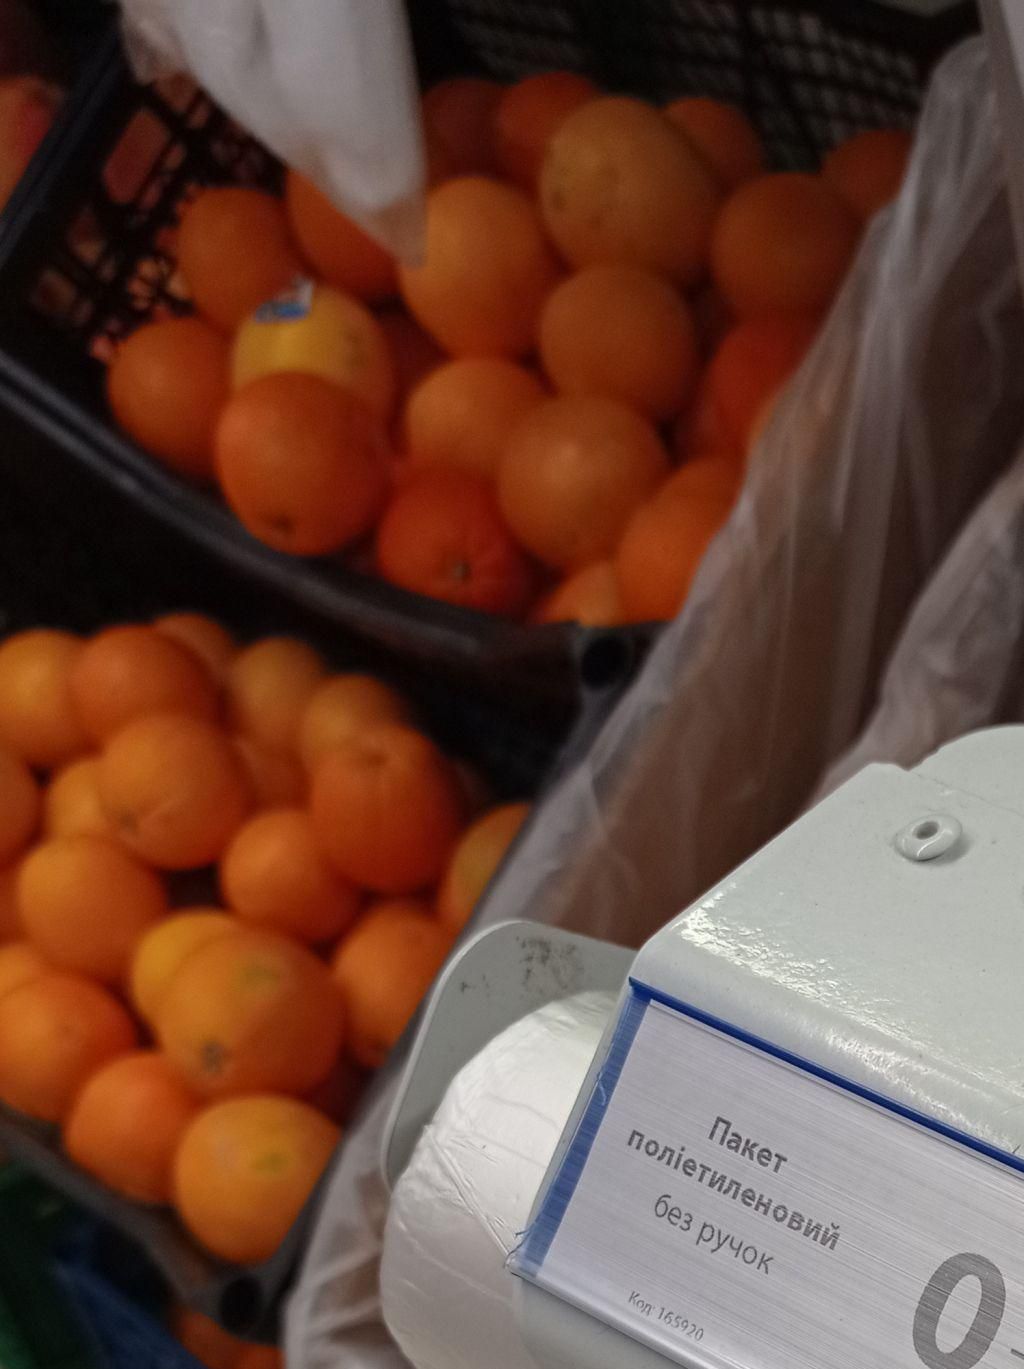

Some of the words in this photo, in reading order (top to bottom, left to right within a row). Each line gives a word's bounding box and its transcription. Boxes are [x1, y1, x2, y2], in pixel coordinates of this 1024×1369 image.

[707, 1116, 788, 1173] Пакет
[627, 1130, 841, 1250] поліетиленовий
[654, 1194, 693, 1232] без
[696, 1221, 775, 1275] ручок
[657, 1306, 705, 1342] 165920
